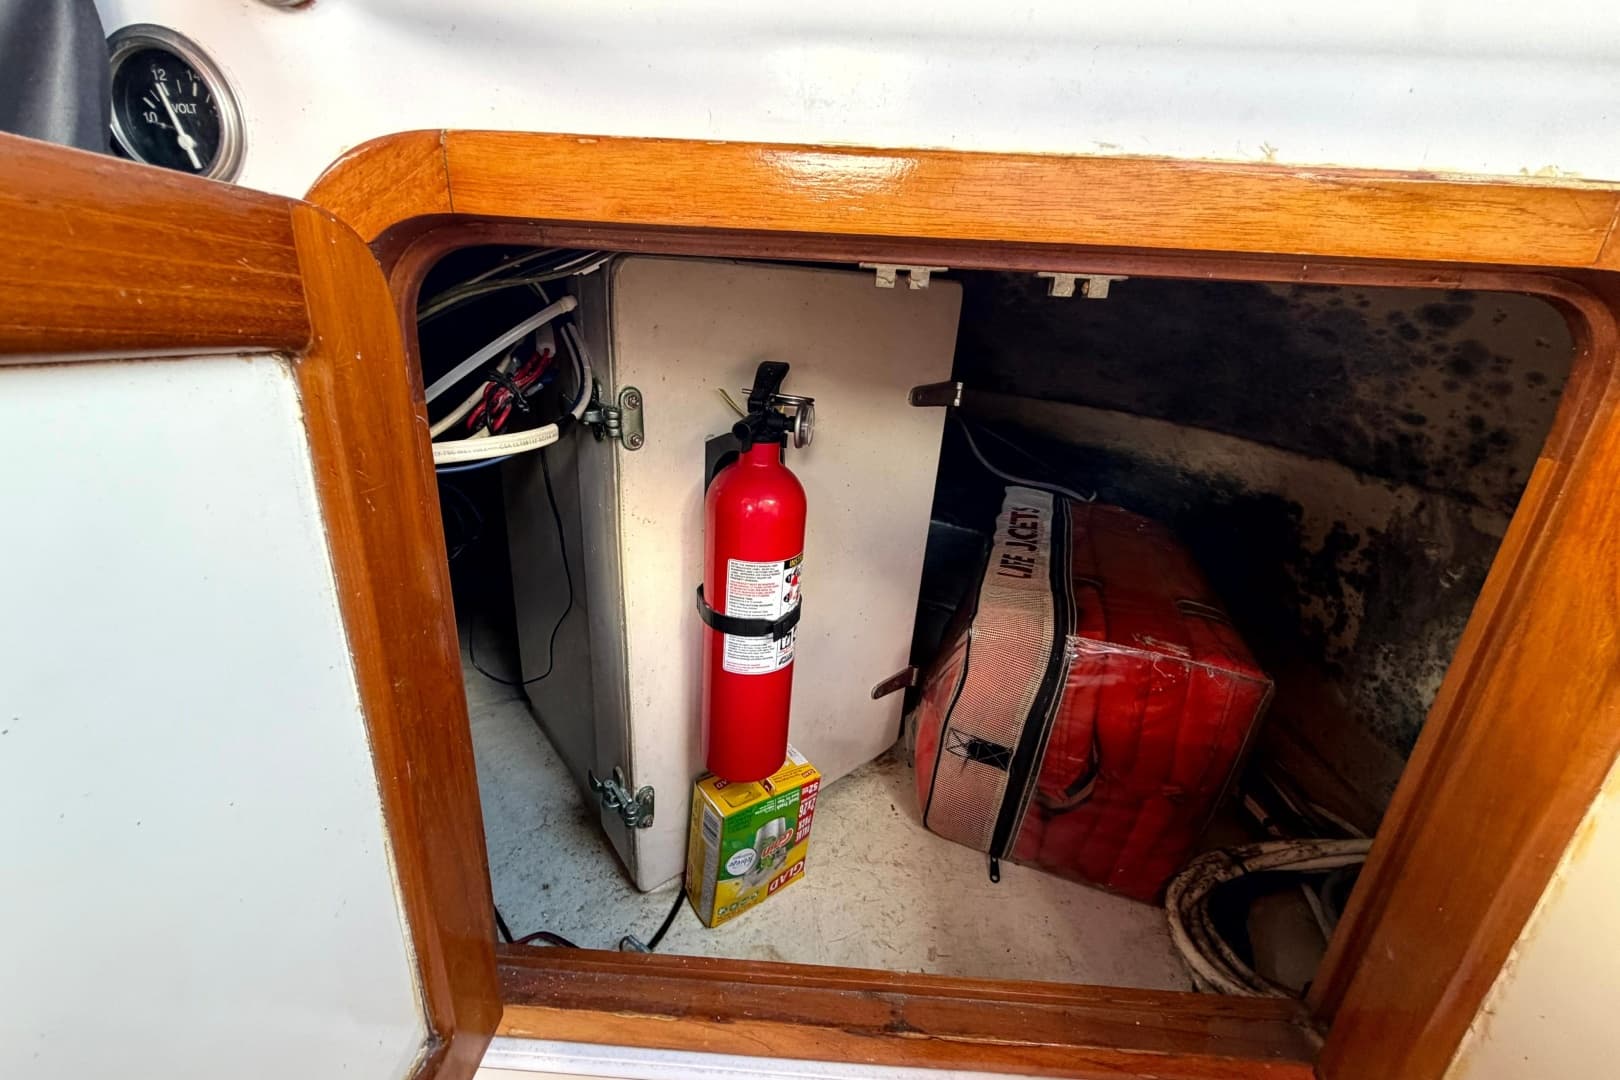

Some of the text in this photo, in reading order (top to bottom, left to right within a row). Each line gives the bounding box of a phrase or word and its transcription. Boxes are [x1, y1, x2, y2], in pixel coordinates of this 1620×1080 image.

[151, 68, 168, 81] 12
[172, 103, 197, 114] VOLT
[997, 553, 1035, 579] LIFE
[769, 860, 804, 892] GLAD
